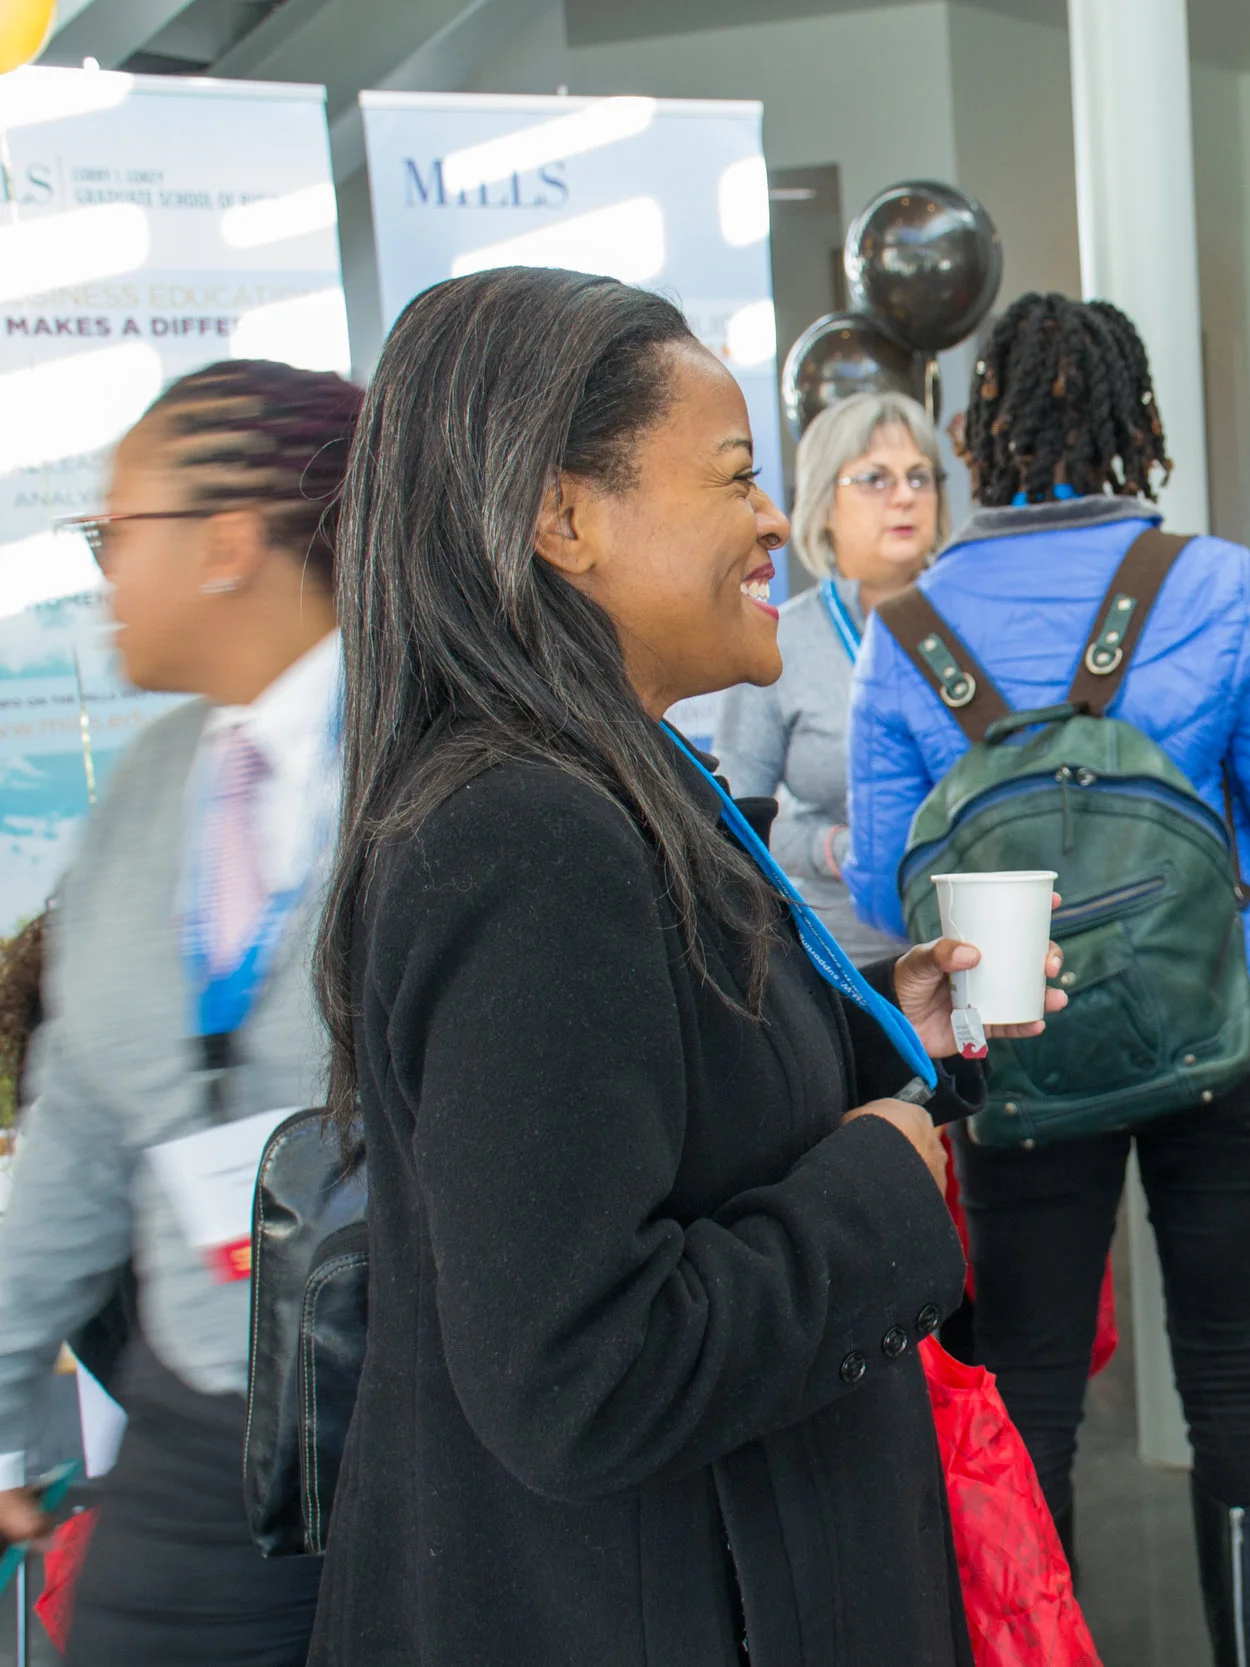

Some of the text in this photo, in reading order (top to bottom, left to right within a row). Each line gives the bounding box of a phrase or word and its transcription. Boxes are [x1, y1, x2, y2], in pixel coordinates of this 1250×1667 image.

[401, 157, 570, 210] MLLS
[5, 316, 242, 338] MAKES A DIFFE
